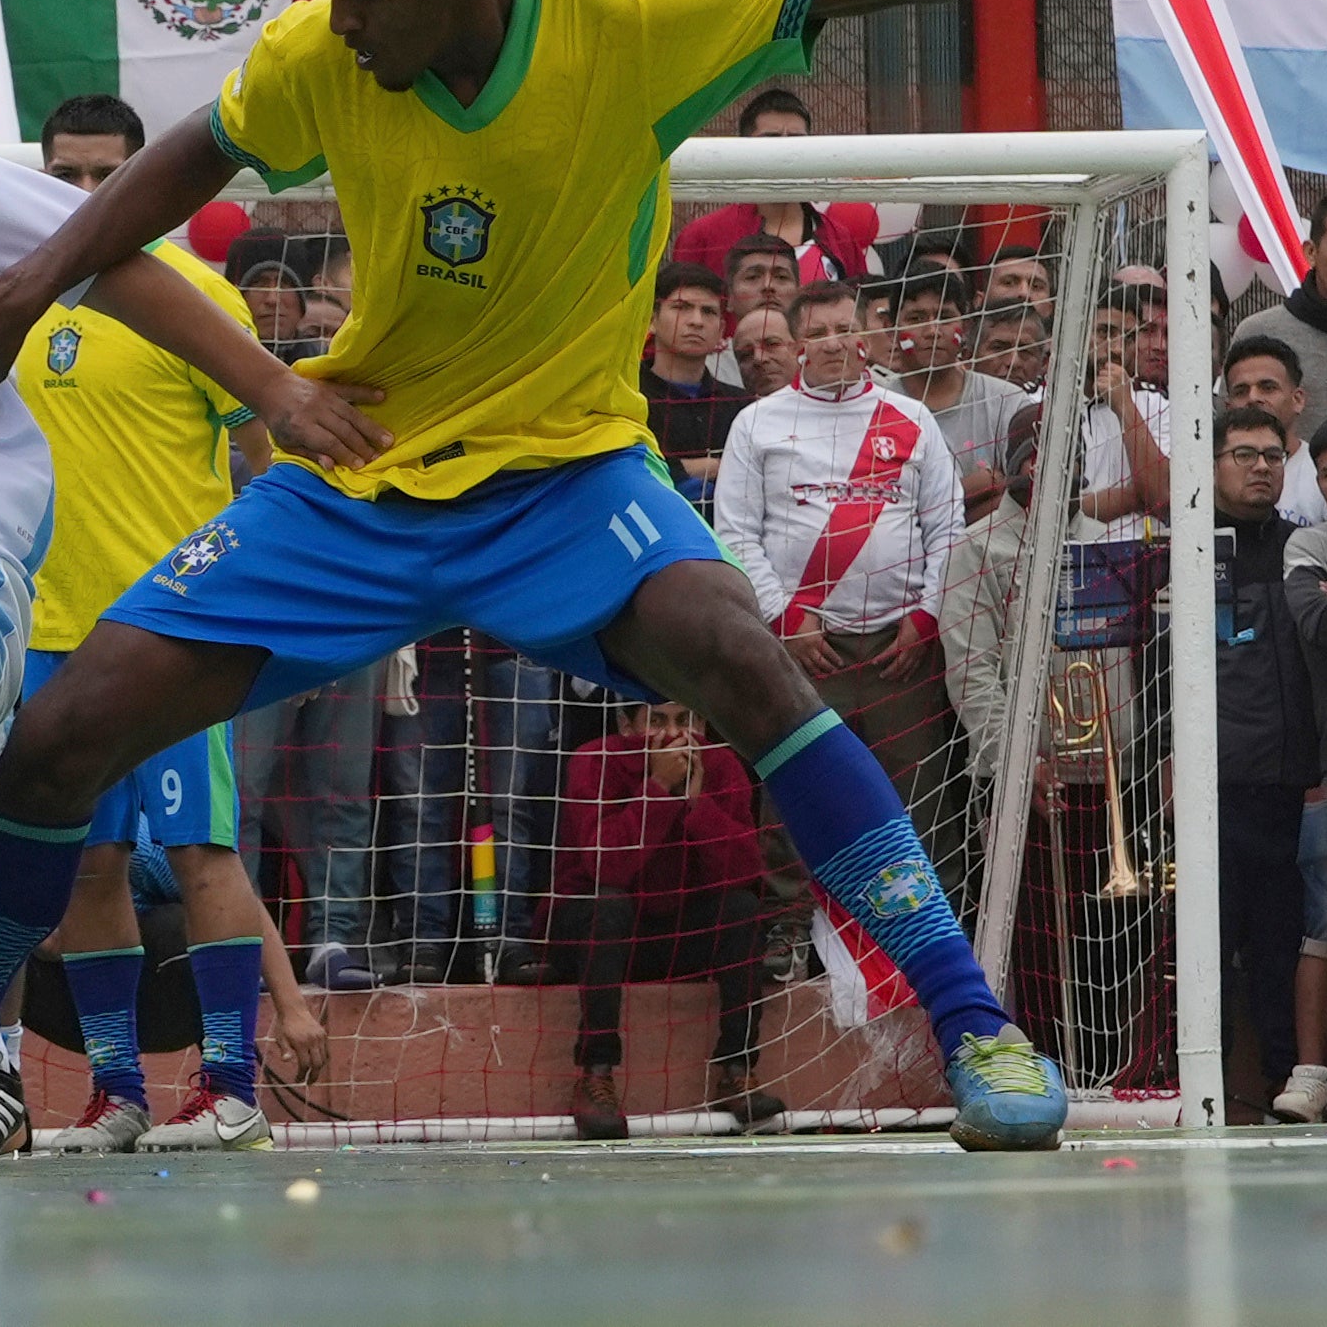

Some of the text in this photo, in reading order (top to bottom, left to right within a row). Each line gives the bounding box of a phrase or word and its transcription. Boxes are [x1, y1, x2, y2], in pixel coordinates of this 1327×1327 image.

[445, 225, 468, 235] CBF
[416, 264, 488, 290] BRASIL
[44, 377, 78, 389] BRASIL
[607, 499, 662, 562] 11
[153, 573, 188, 597] BRASIL
[161, 768, 183, 816] 9
